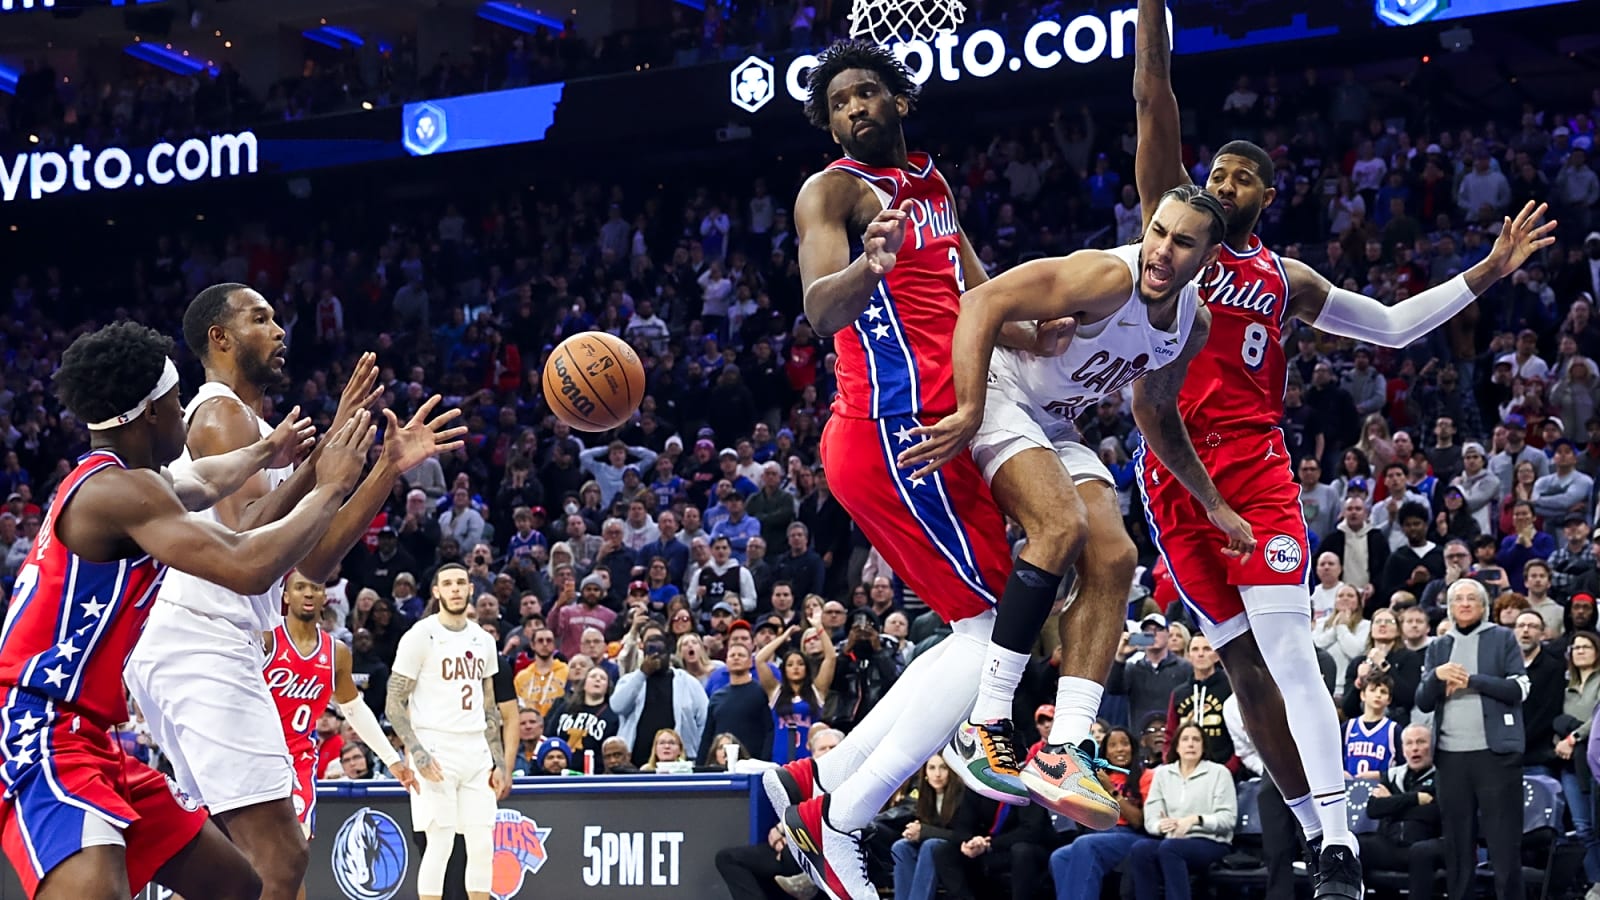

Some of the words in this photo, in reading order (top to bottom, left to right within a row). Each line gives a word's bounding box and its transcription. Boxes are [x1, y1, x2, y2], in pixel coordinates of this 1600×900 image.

[1192, 261, 1276, 315] Phila
[1154, 346, 1175, 358] CLIFFS
[1241, 322, 1269, 367] 8
[555, 355, 595, 417] Wilson
[267, 667, 325, 701] Phila
[442, 656, 485, 681] CAVS
[461, 684, 473, 711] 2
[291, 704, 312, 733] 0
[494, 819, 545, 860] ICKS
[582, 825, 645, 887] 5PM
[651, 832, 685, 886] ET
